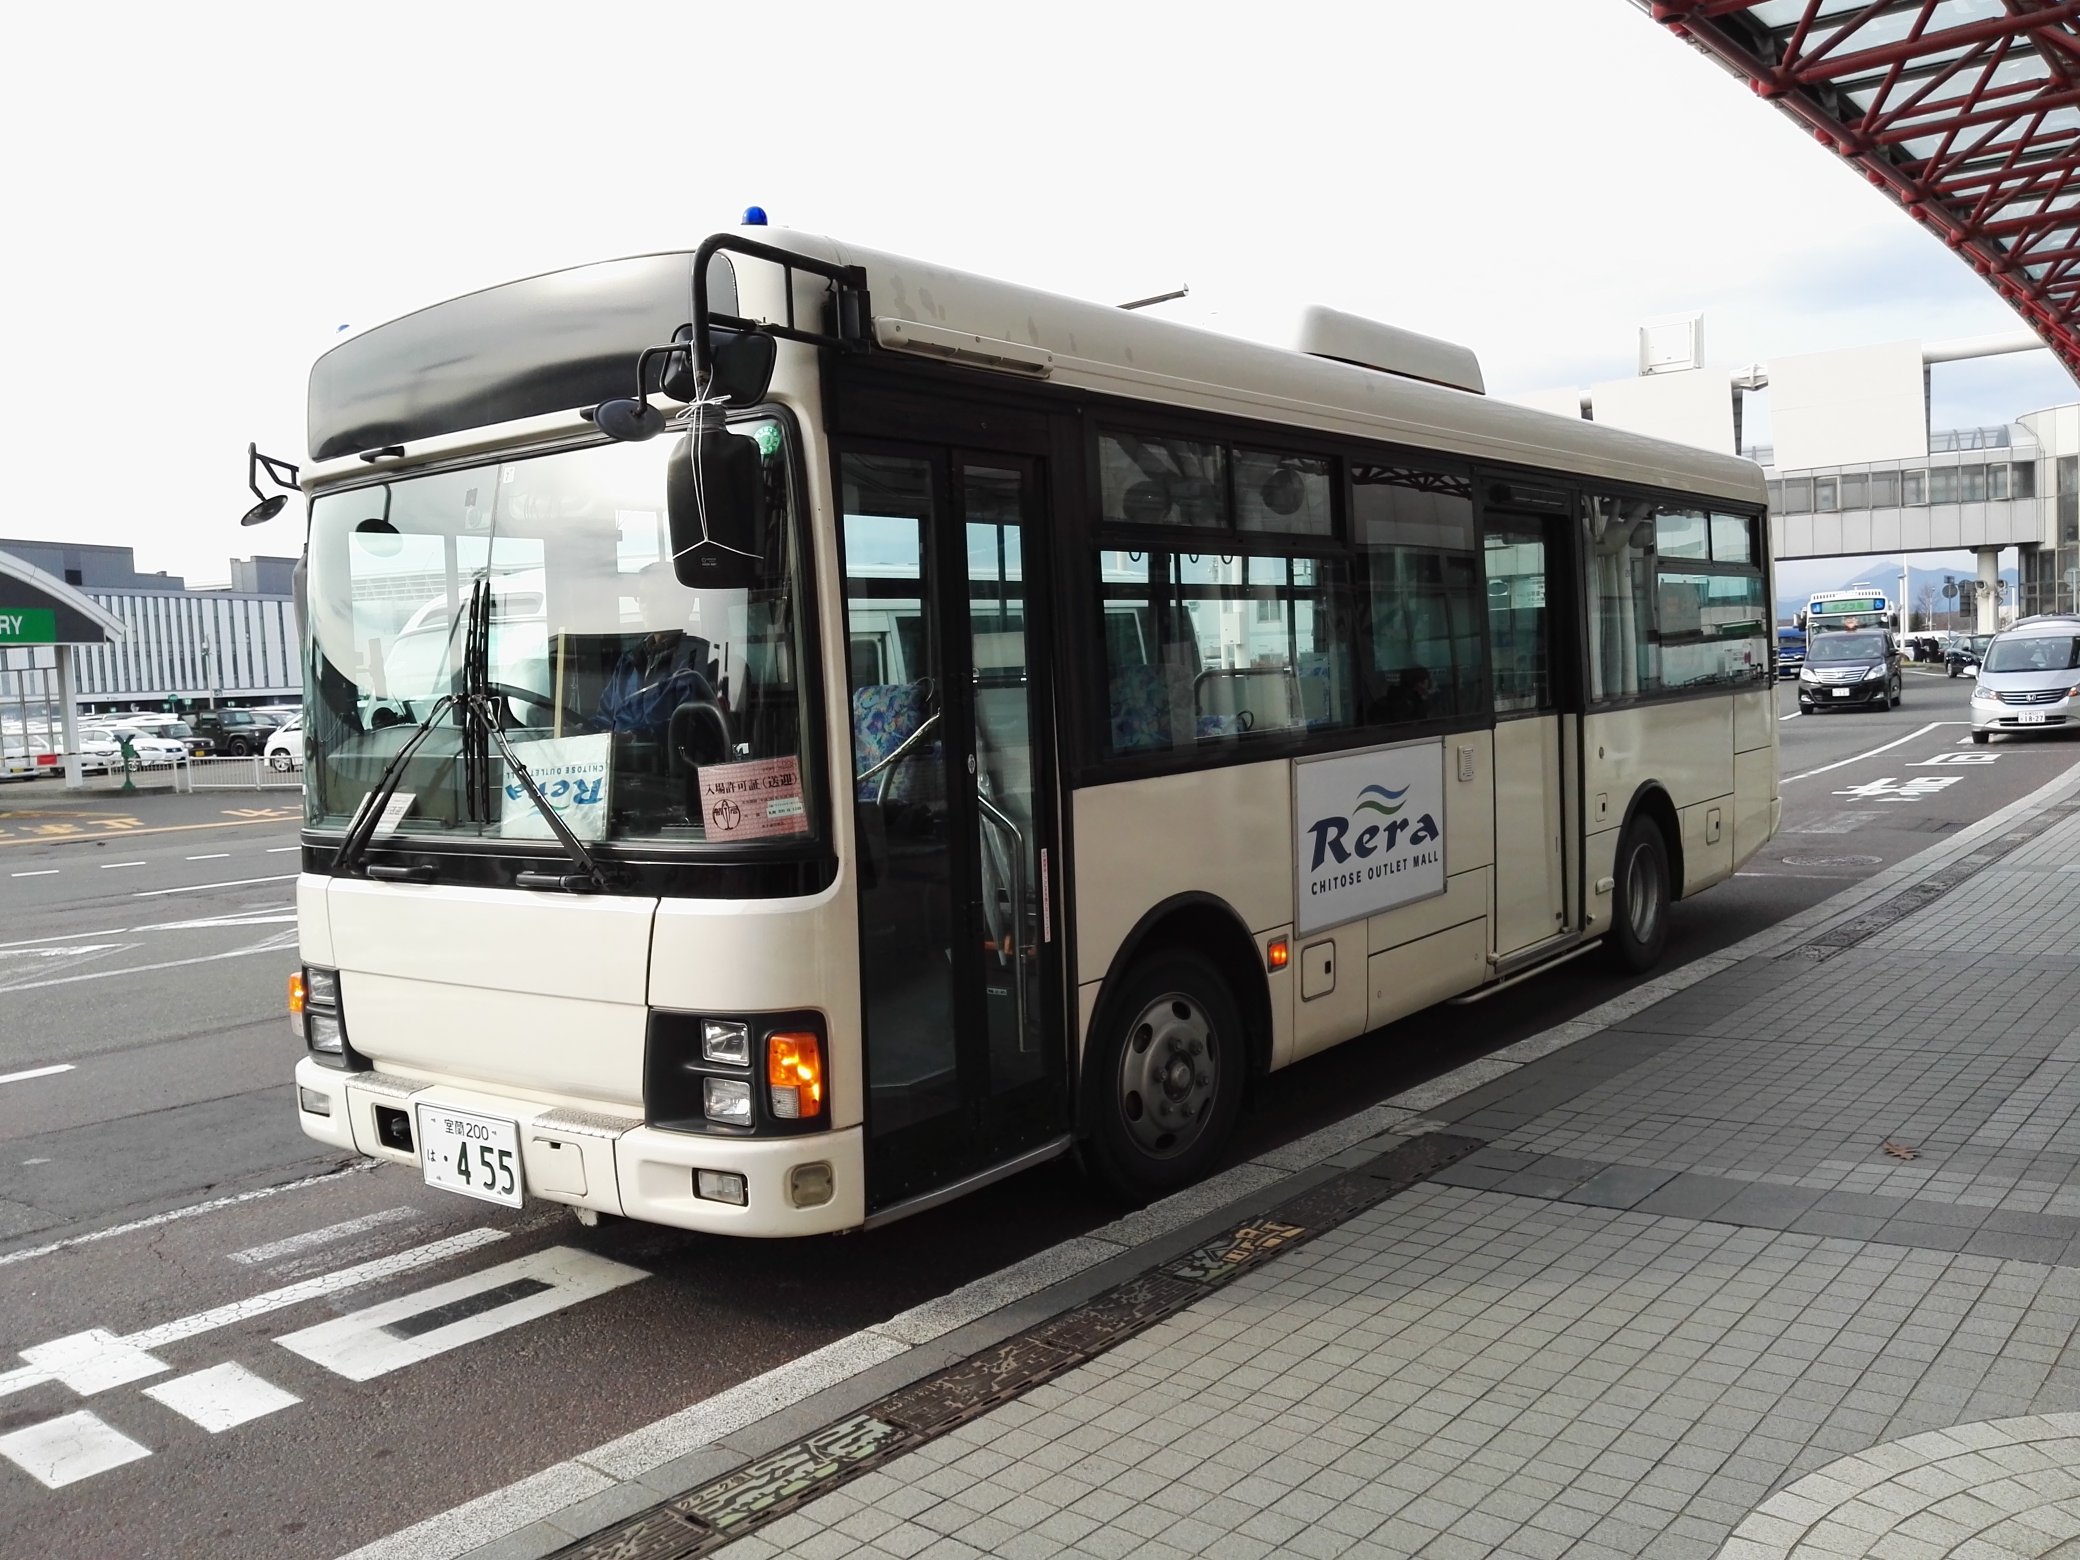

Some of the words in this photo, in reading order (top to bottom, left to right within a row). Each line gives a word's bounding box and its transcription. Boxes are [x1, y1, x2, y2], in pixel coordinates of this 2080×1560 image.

[566, 765, 604, 774] CHITOSE
[1307, 813, 1440, 873] Rera
[1311, 870, 1362, 896] CHITOSE
[1367, 858, 1409, 881] OUTLET
[1413, 850, 1439, 868] MALL
